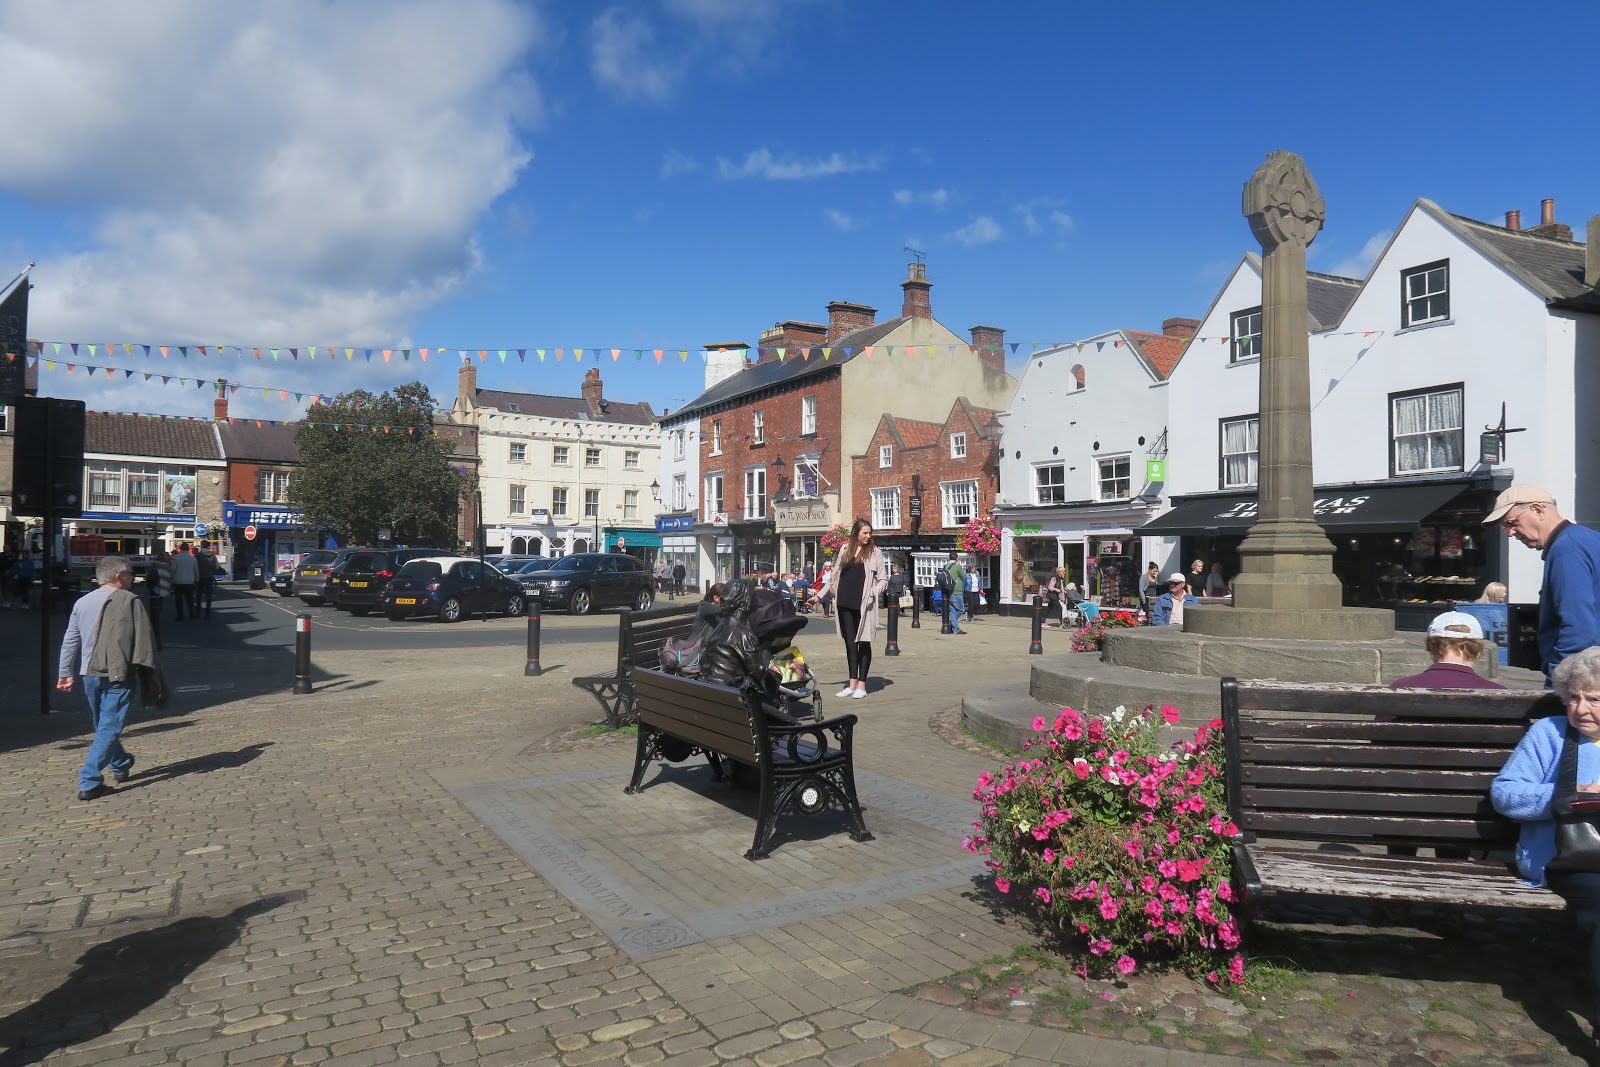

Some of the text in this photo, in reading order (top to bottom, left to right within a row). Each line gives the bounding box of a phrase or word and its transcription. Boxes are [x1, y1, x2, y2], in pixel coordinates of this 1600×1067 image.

[1229, 496, 1370, 512] TAS
[250, 511, 307, 525] BETFRE
[1236, 507, 1357, 518] BER
[561, 860, 633, 917] FOUNDATION
